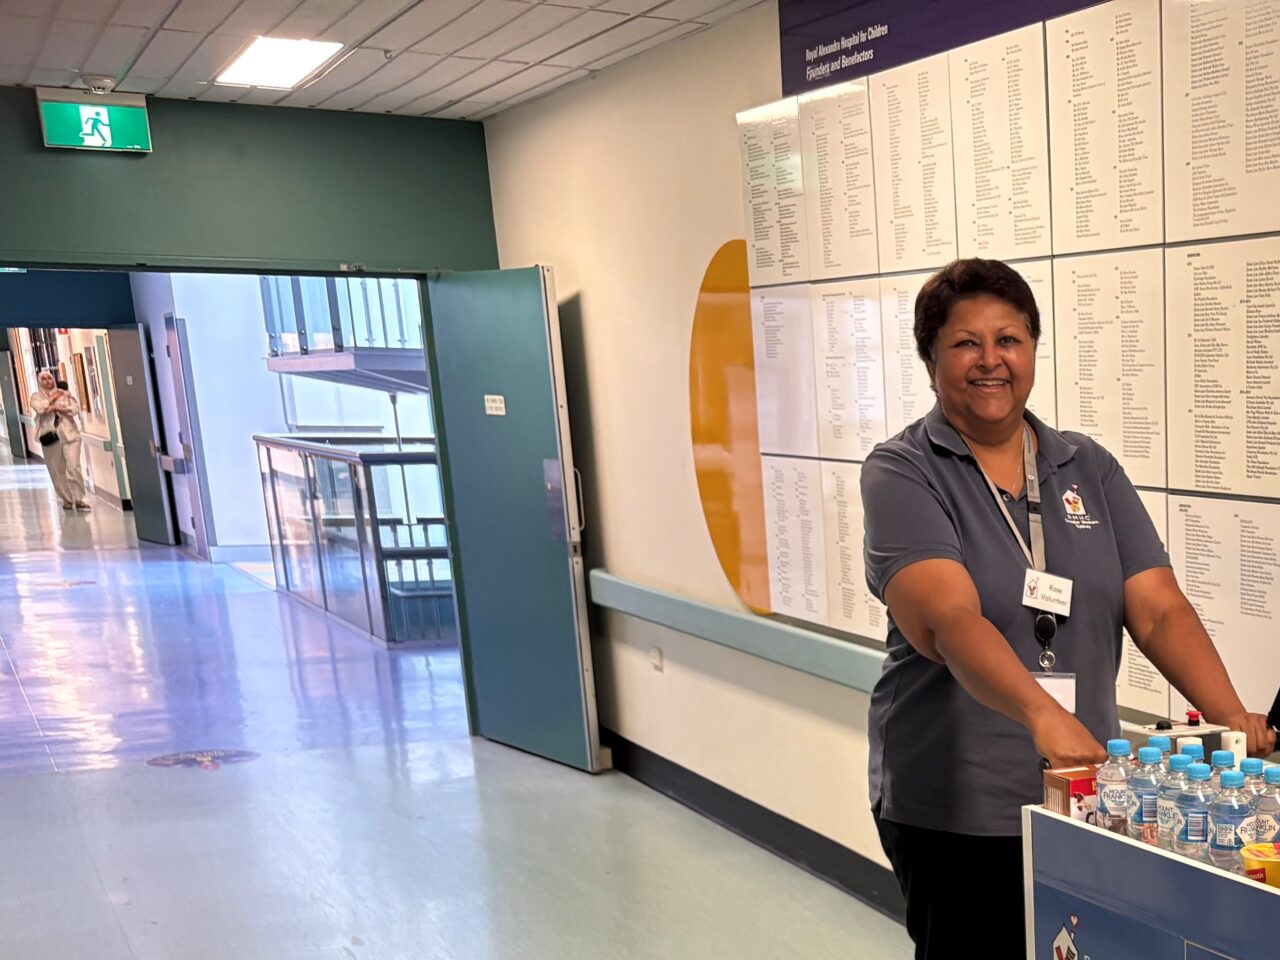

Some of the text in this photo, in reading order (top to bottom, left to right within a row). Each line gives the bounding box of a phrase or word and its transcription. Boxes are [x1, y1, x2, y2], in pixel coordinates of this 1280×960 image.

[806, 46, 818, 62] Royal
[818, 40, 840, 57] Alexandra
[841, 32, 859, 49] Hospital
[868, 24, 888, 40] Children
[806, 49, 874, 80] Founders and Benefactors
[1049, 584, 1062, 594] Rose
[1041, 594, 1067, 606] Volunteer
